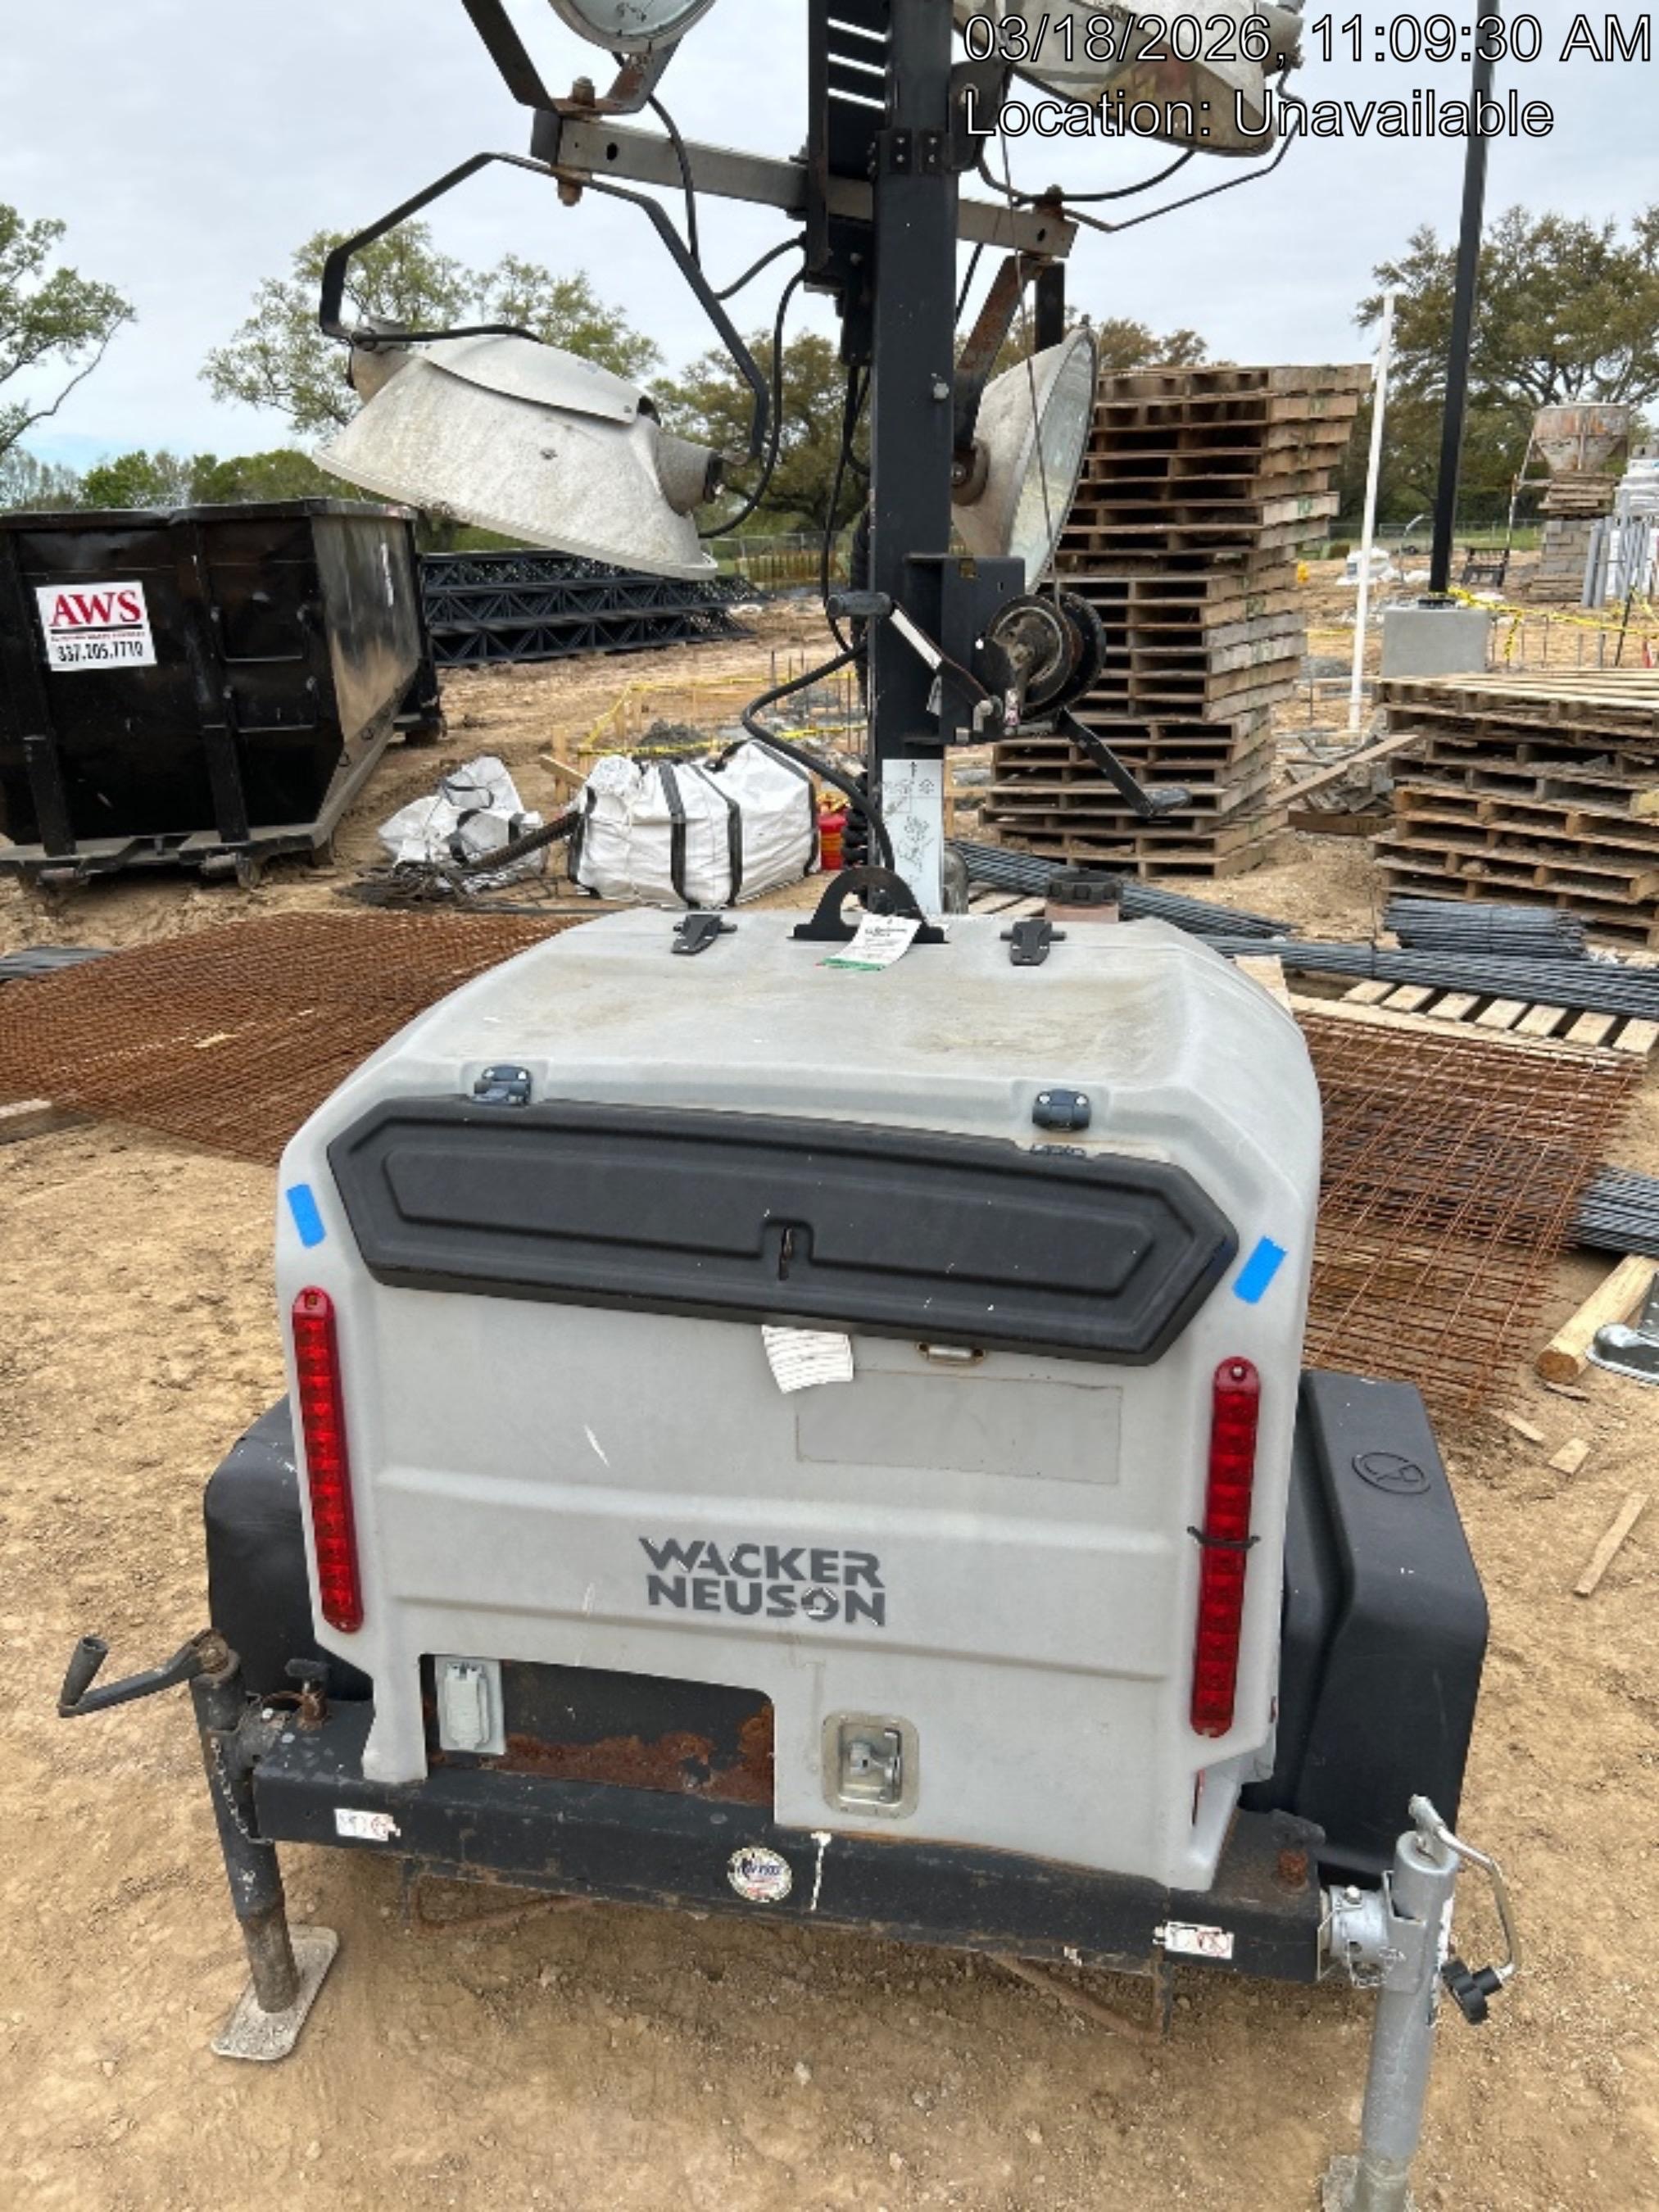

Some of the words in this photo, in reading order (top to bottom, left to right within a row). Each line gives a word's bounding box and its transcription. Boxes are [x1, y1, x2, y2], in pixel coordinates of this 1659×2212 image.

[48, 590, 142, 627] AWS
[638, 1536, 886, 1589] WACKER
[646, 1574, 886, 1627] NEUSON
